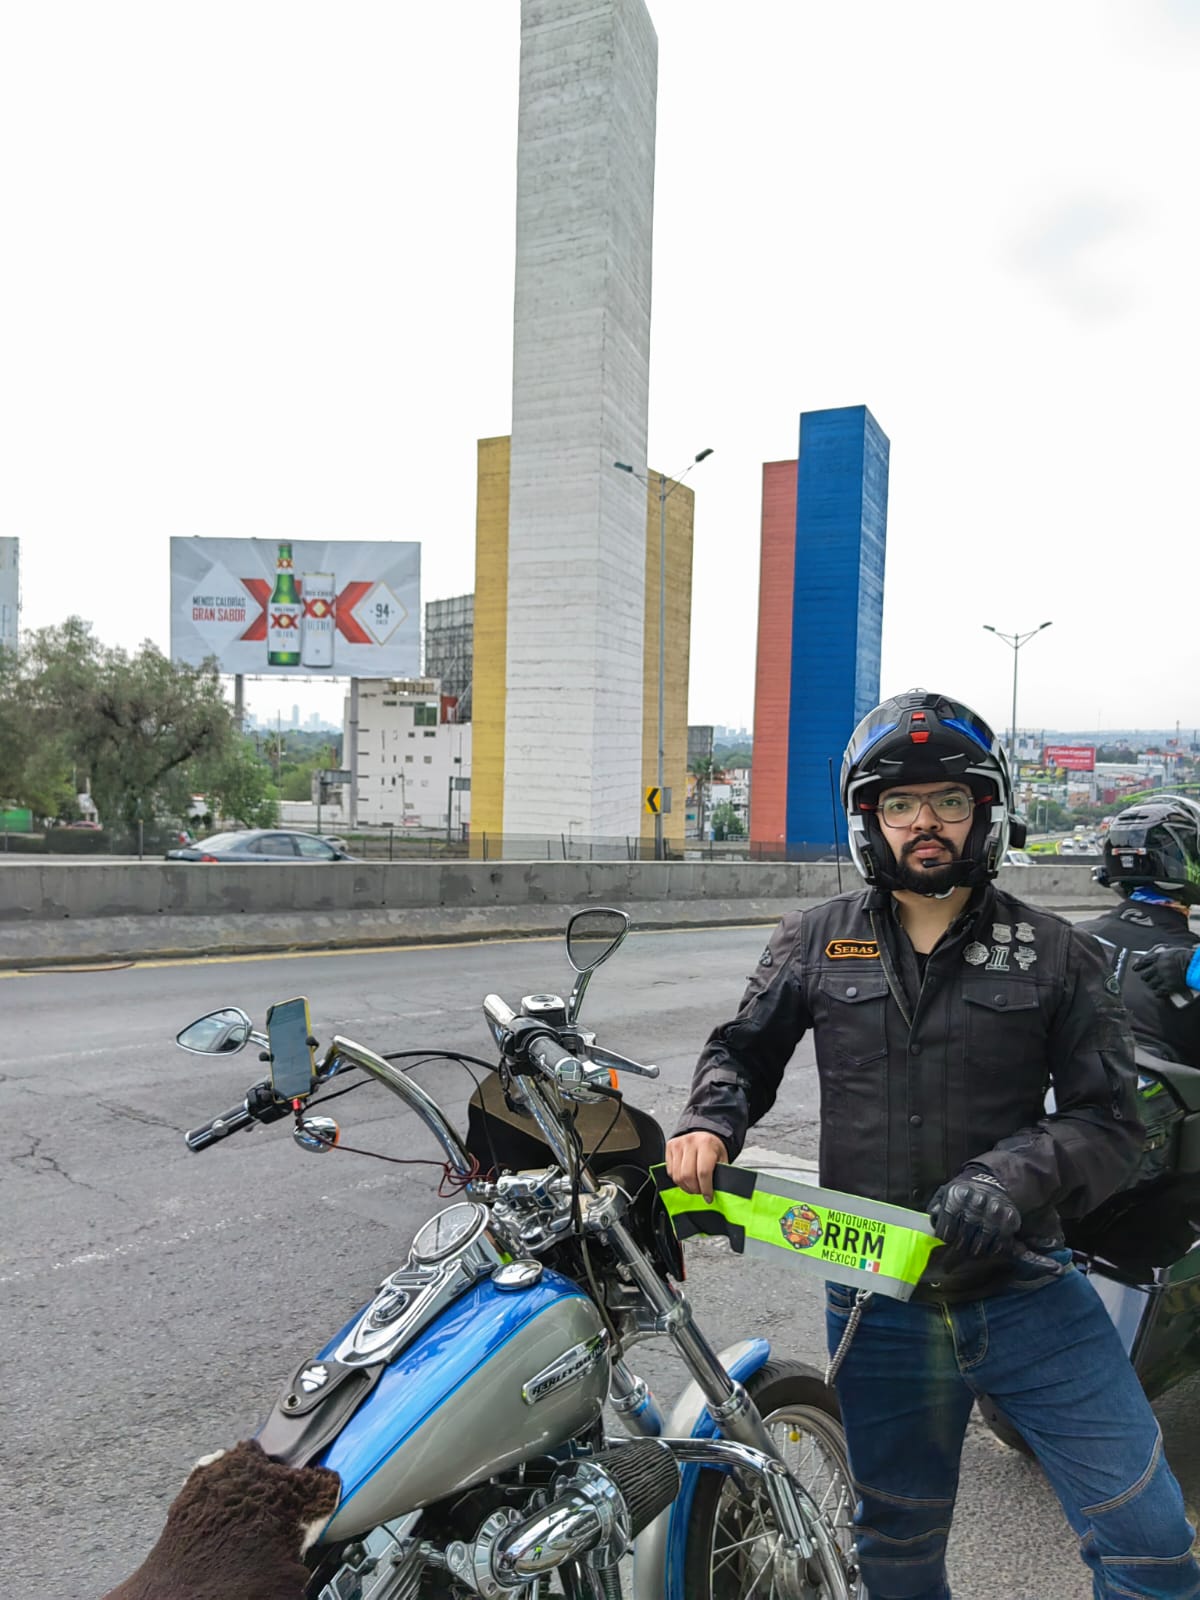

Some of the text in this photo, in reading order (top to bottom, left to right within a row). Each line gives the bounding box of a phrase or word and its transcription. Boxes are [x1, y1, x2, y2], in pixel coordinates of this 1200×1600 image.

[192, 596, 214, 606] MENOS
[192, 607, 246, 622] GRAN SABOR
[376, 603, 389, 617] 94
[827, 1210, 886, 1234] MOTOTURISTA
[823, 1223, 884, 1259] RRM
[821, 1248, 857, 1267] MÉXICO
